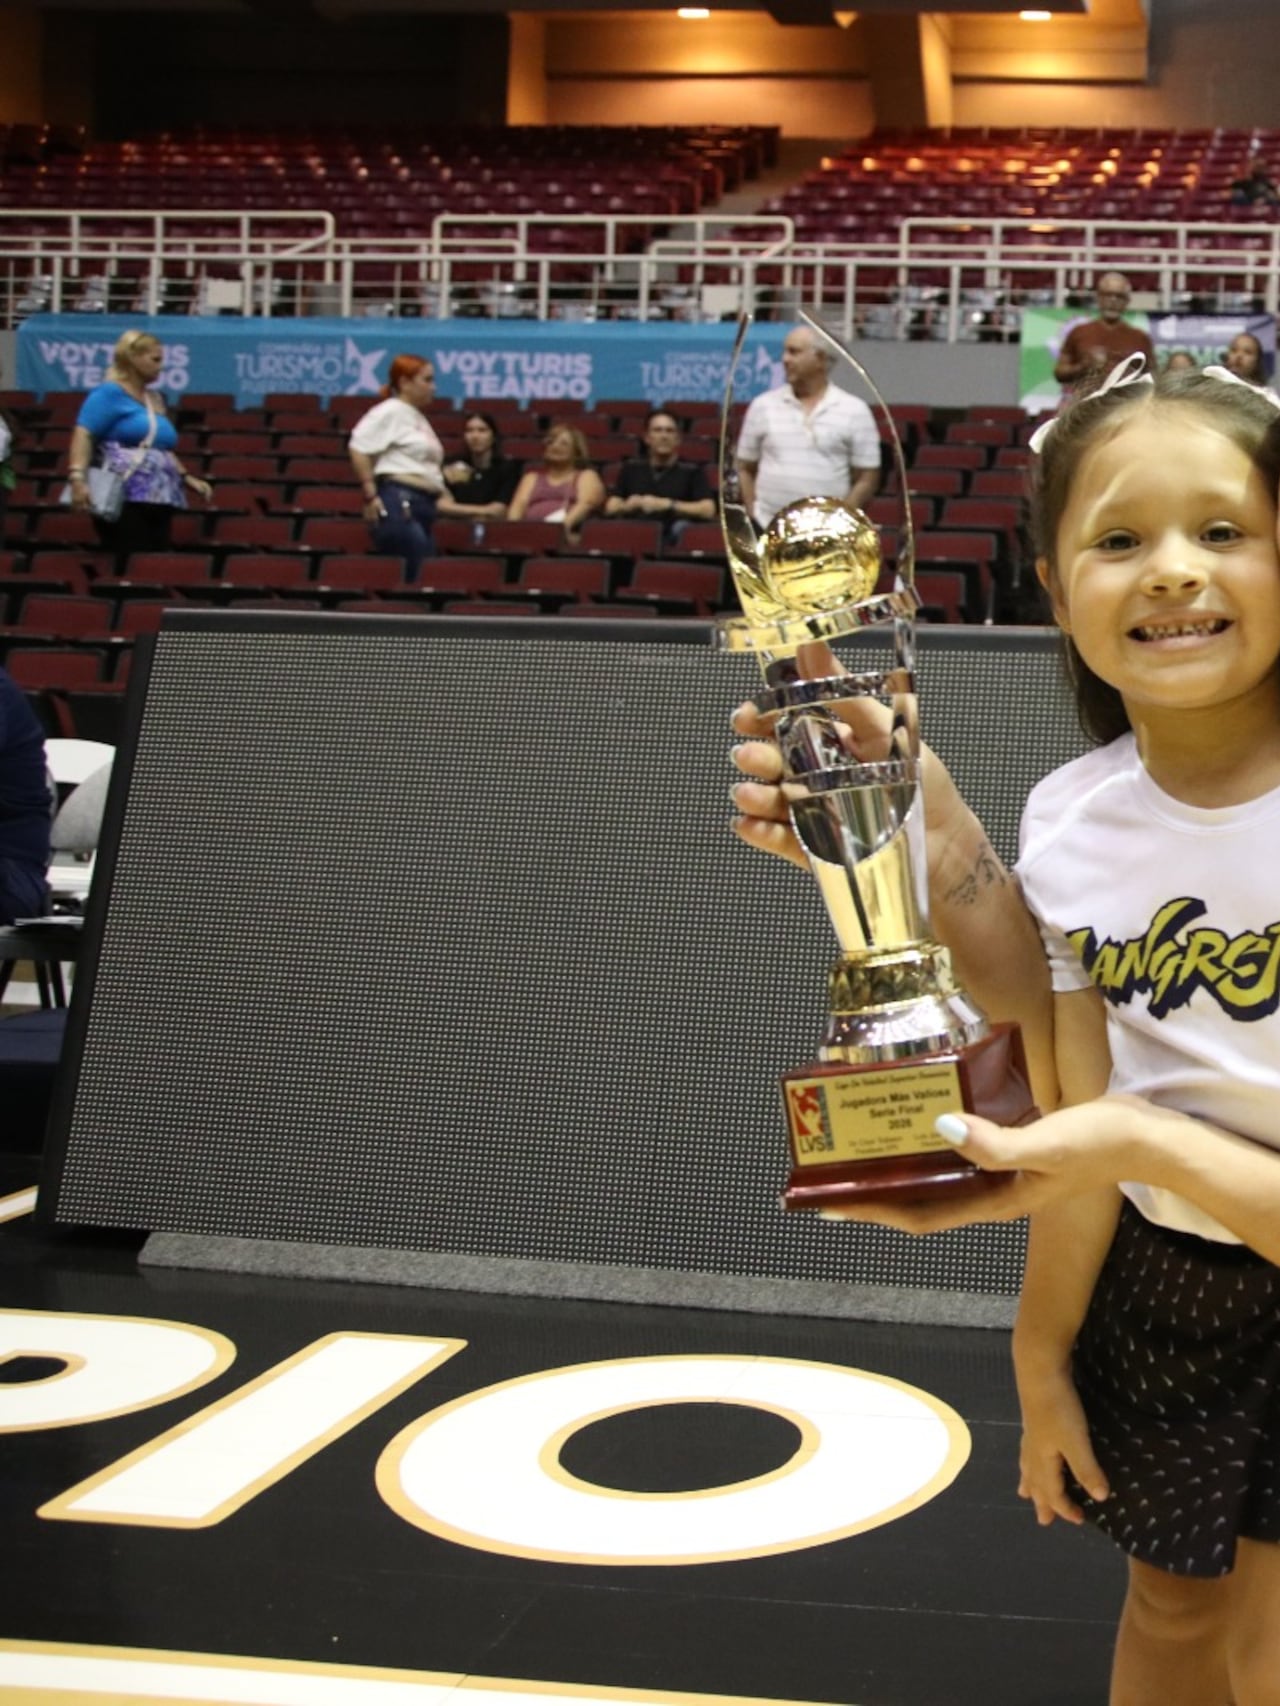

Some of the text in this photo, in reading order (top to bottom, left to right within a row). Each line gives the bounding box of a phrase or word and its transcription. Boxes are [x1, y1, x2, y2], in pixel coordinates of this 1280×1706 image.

[235, 353, 342, 380] TURISMO
[640, 361, 752, 388] TURISMO
[462, 374, 592, 399] TEANDO
[869, 1103, 925, 1118] Serie Final
[799, 1135, 825, 1154] LVS
